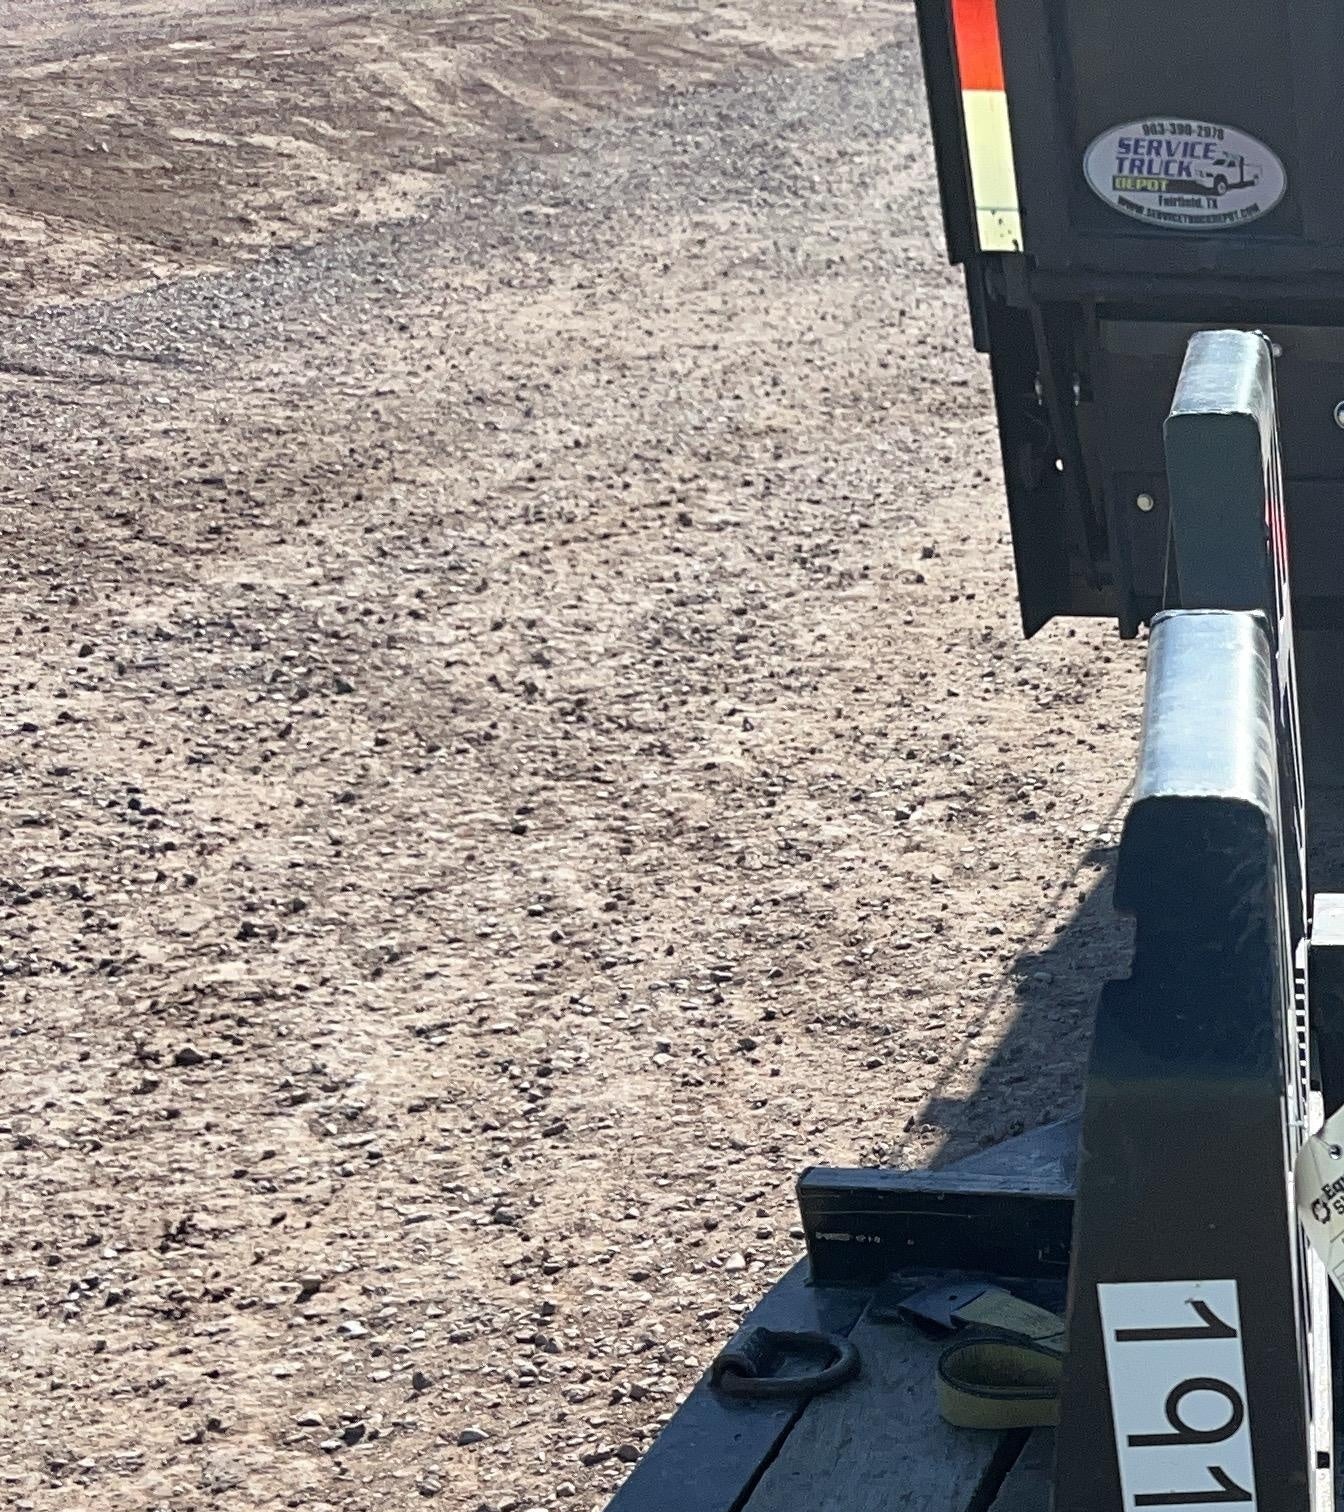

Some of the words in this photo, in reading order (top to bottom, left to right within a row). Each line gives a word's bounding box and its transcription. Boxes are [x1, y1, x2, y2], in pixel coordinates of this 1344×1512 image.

[1117, 136, 1218, 160] SERVICE
[1114, 156, 1193, 178] TRUCK
[1114, 176, 1169, 192] DEPOT
